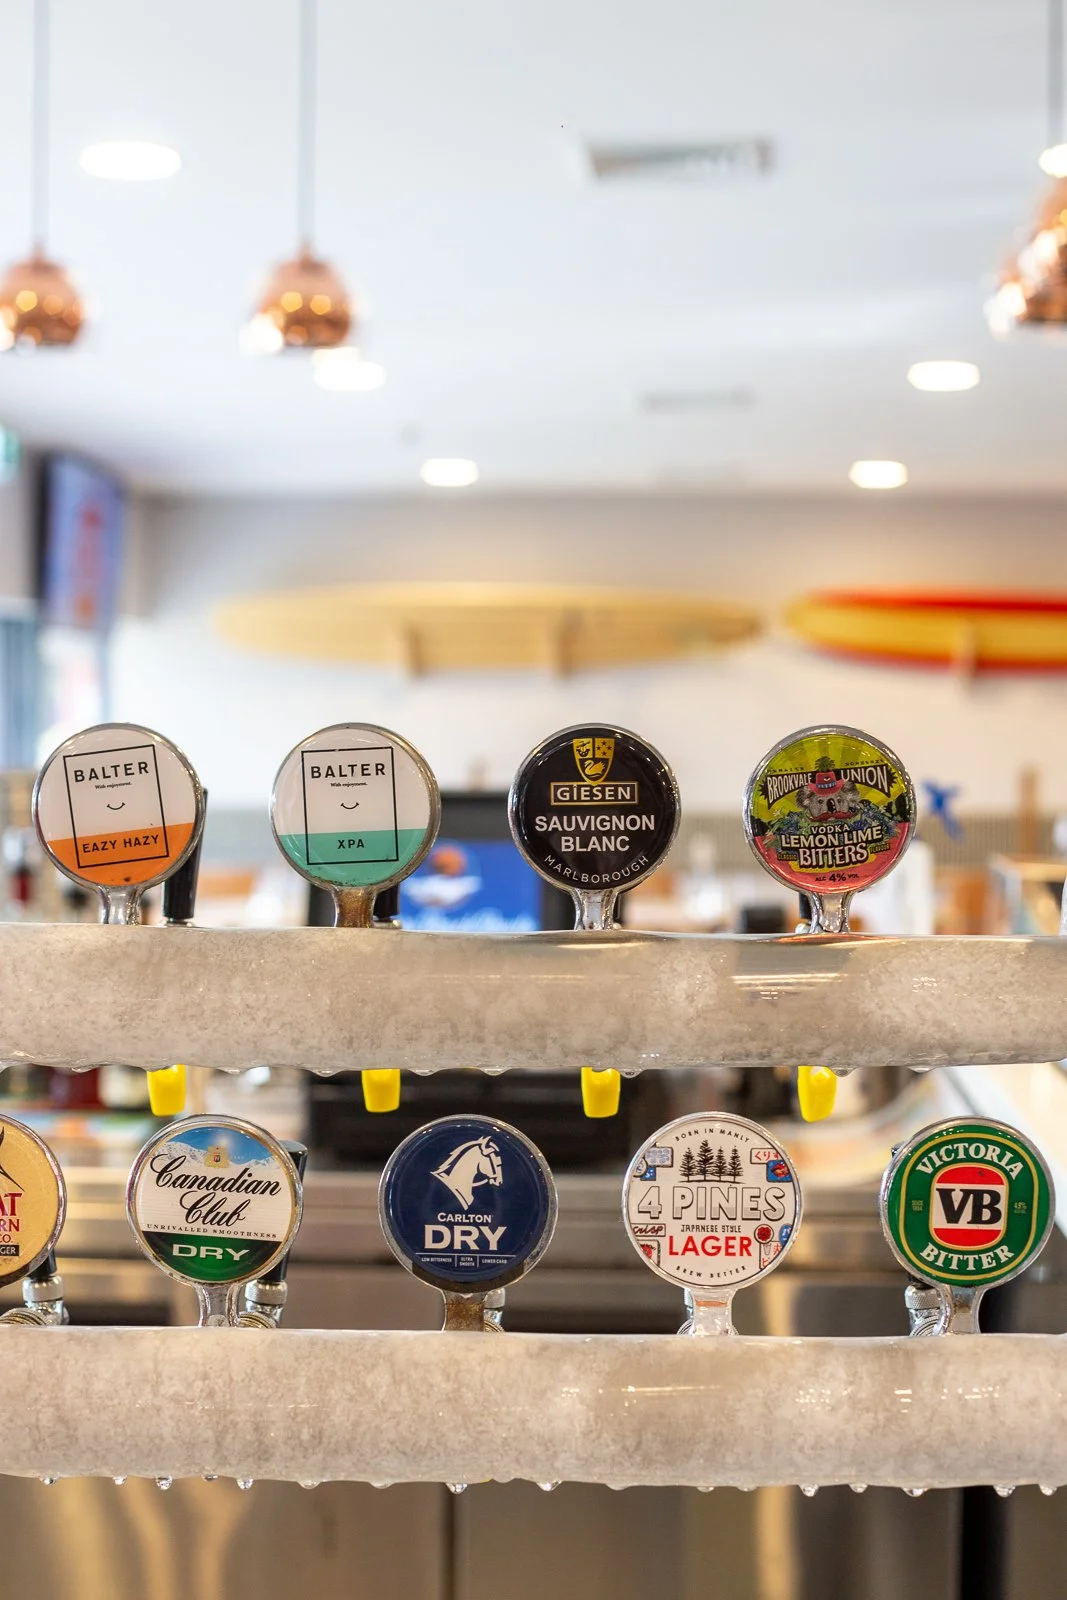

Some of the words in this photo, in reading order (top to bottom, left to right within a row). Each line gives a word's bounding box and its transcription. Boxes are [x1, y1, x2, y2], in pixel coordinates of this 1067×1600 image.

[74, 761, 150, 782] BALTER
[311, 763, 386, 779] BALTER
[556, 785, 631, 801] GIESEN
[766, 772, 813, 804] BROOKVALE
[840, 765, 889, 793] UNION
[534, 815, 655, 832] SAUVIGNON
[811, 824, 850, 834] VODKA
[82, 839, 117, 853] EAZY
[123, 834, 160, 848] HAZY
[337, 839, 365, 850] XPA
[561, 836, 630, 852] BLANC
[781, 834, 839, 848] LEMON
[843, 826, 882, 845] LIME
[799, 842, 868, 866] BITTERS
[544, 854, 649, 884] MARLBOROUGH
[829, 873, 847, 882] 4%
[675, 1129, 700, 1142] BORN
[720, 1128, 750, 1143] MANLY
[916, 1142, 1024, 1180] VICTORIA
[150, 1153, 282, 1197] Canadian
[179, 1190, 251, 1227] Club
[638, 1186, 662, 1220] 4
[672, 1186, 786, 1222] PINES
[936, 1188, 1003, 1225] VB
[437, 1212, 492, 1223] CARLTON
[147, 1224, 208, 1234] UNRIVALLED
[212, 1229, 277, 1238] SMOOTHNESS
[424, 1224, 508, 1250] DRY
[680, 1224, 718, 1233] JAPANESE
[721, 1224, 742, 1233] STYLE
[0, 1234, 14, 1244] O.
[668, 1235, 752, 1257] LAGER
[172, 1244, 250, 1261] DRY
[920, 1242, 1015, 1271] BITTER
[676, 1265, 702, 1278] BREW
[710, 1265, 746, 1278] BETTER
